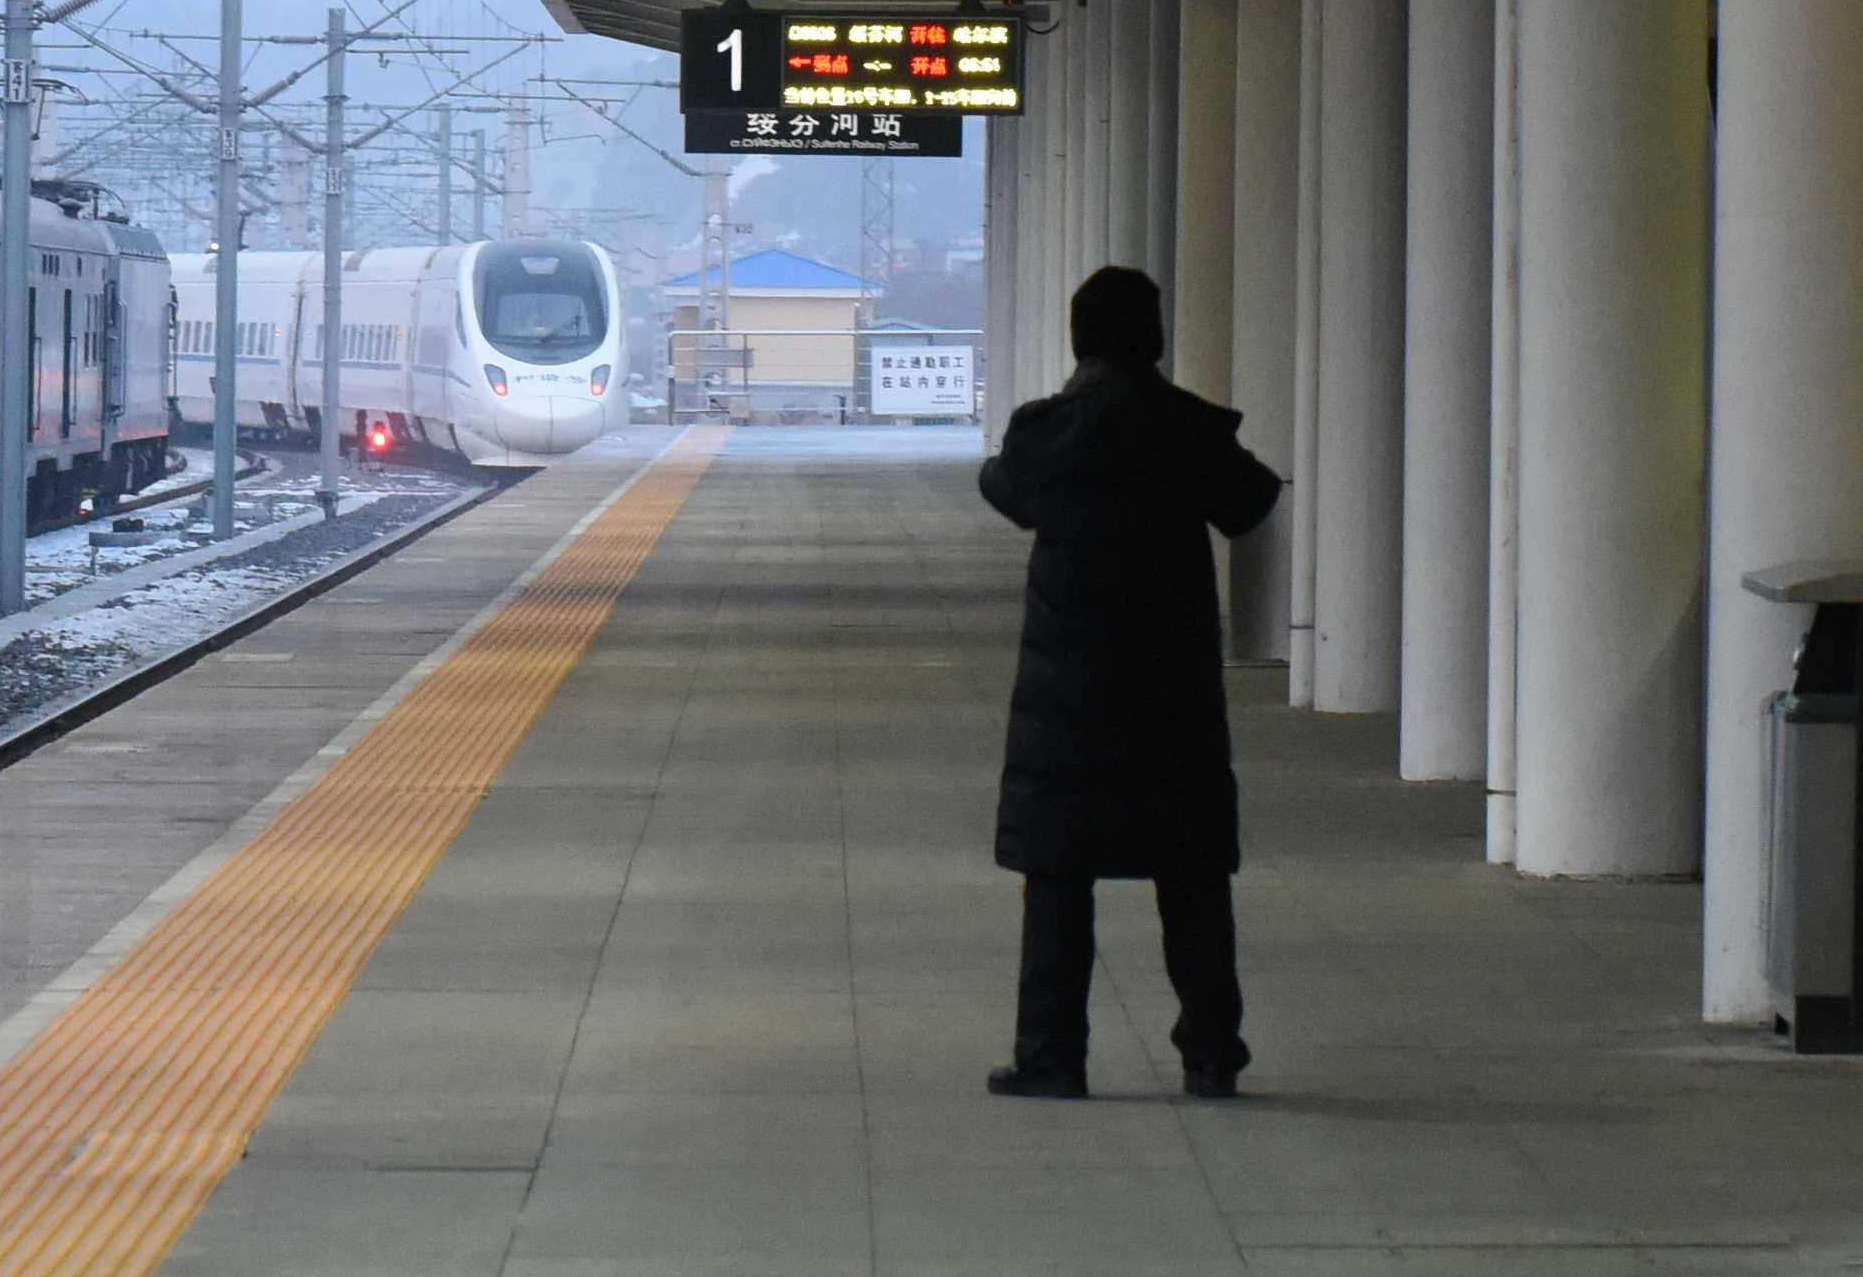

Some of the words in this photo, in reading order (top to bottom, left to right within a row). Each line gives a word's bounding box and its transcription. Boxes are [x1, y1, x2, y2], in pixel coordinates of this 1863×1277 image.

[717, 28, 742, 92] 1
[910, 56, 947, 76] 开点
[882, 375, 965, 389] 在站内穿行
